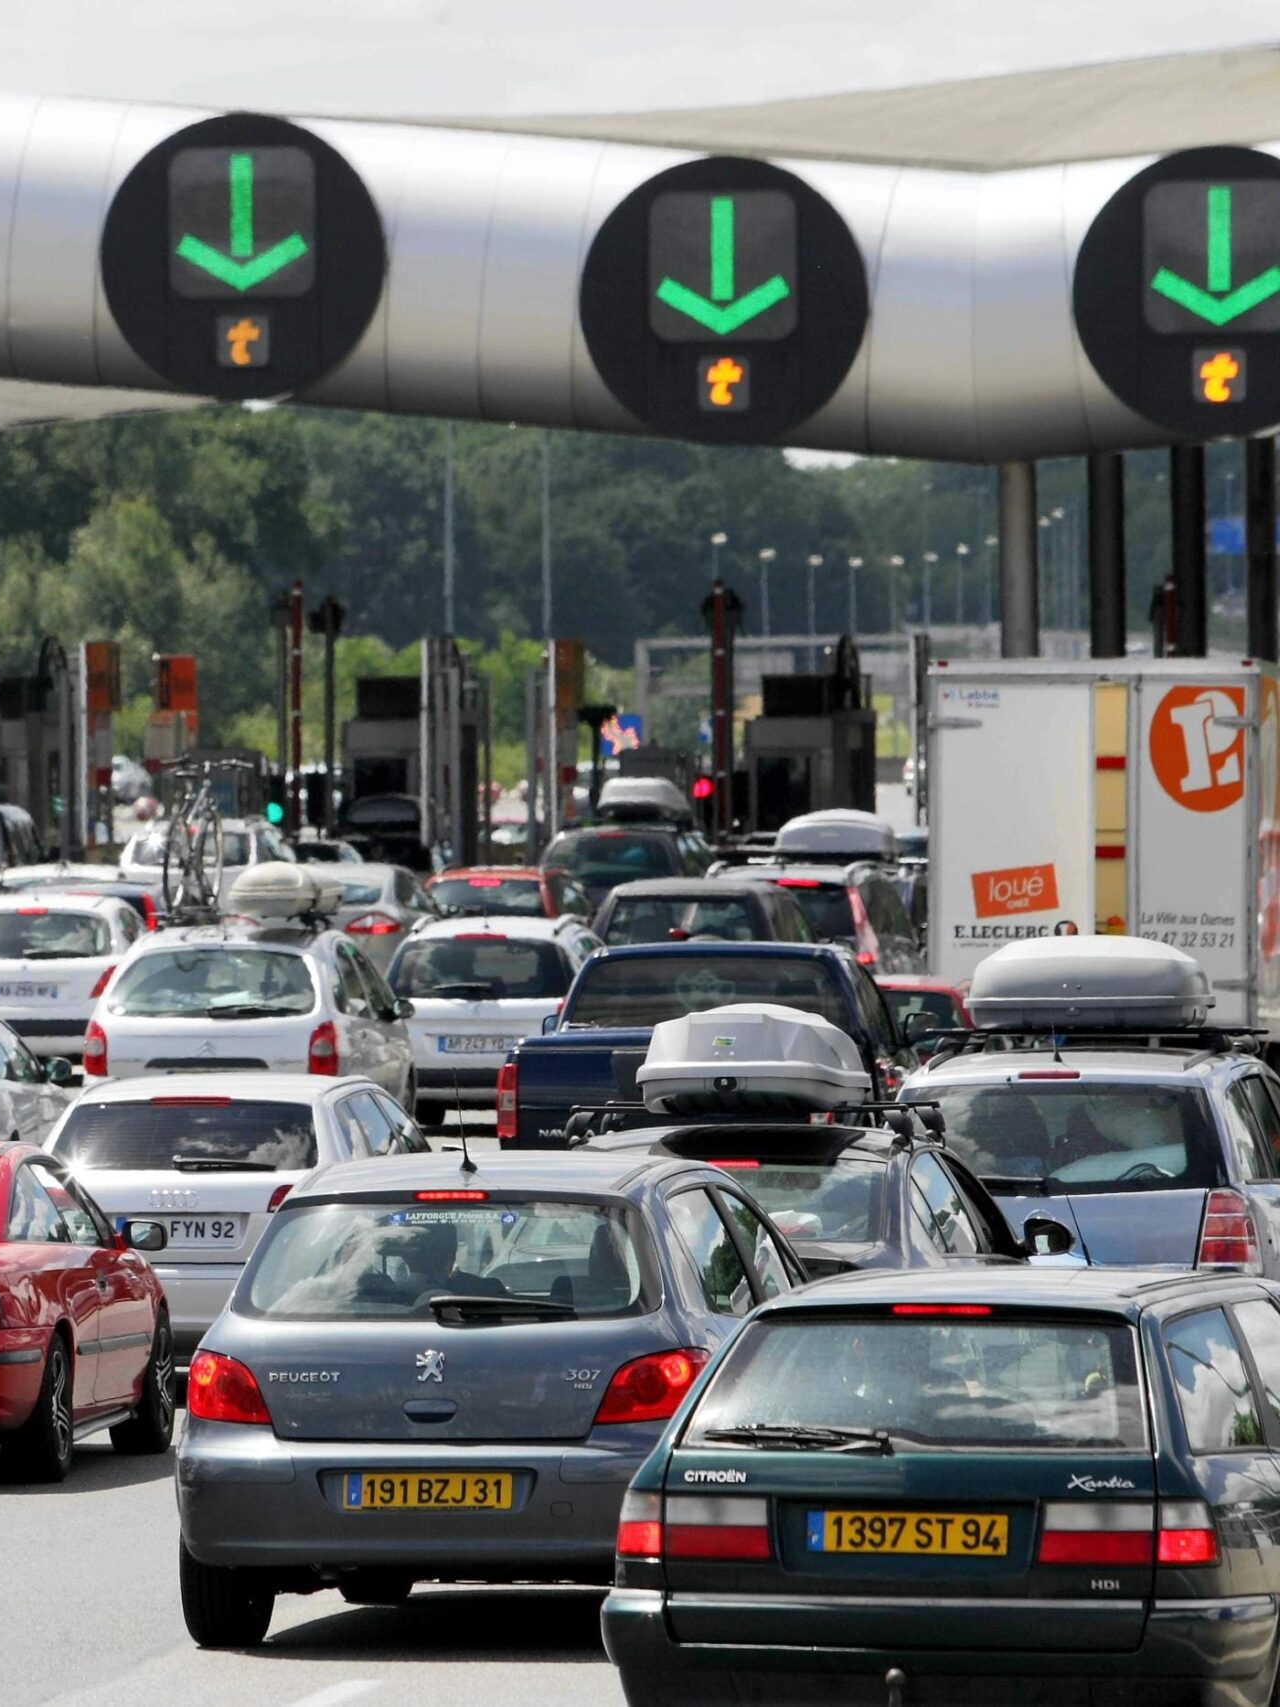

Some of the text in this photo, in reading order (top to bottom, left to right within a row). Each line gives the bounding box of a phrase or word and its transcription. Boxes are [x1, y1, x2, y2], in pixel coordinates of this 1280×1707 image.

[1219, 932, 1235, 948] 21
[170, 1221, 235, 1238] FYN 92
[269, 1371, 340, 1382] PEUGEOT
[565, 1369, 601, 1380] 307
[684, 1468, 747, 1483] CITROËN
[1067, 1474, 1136, 1492] Xantia
